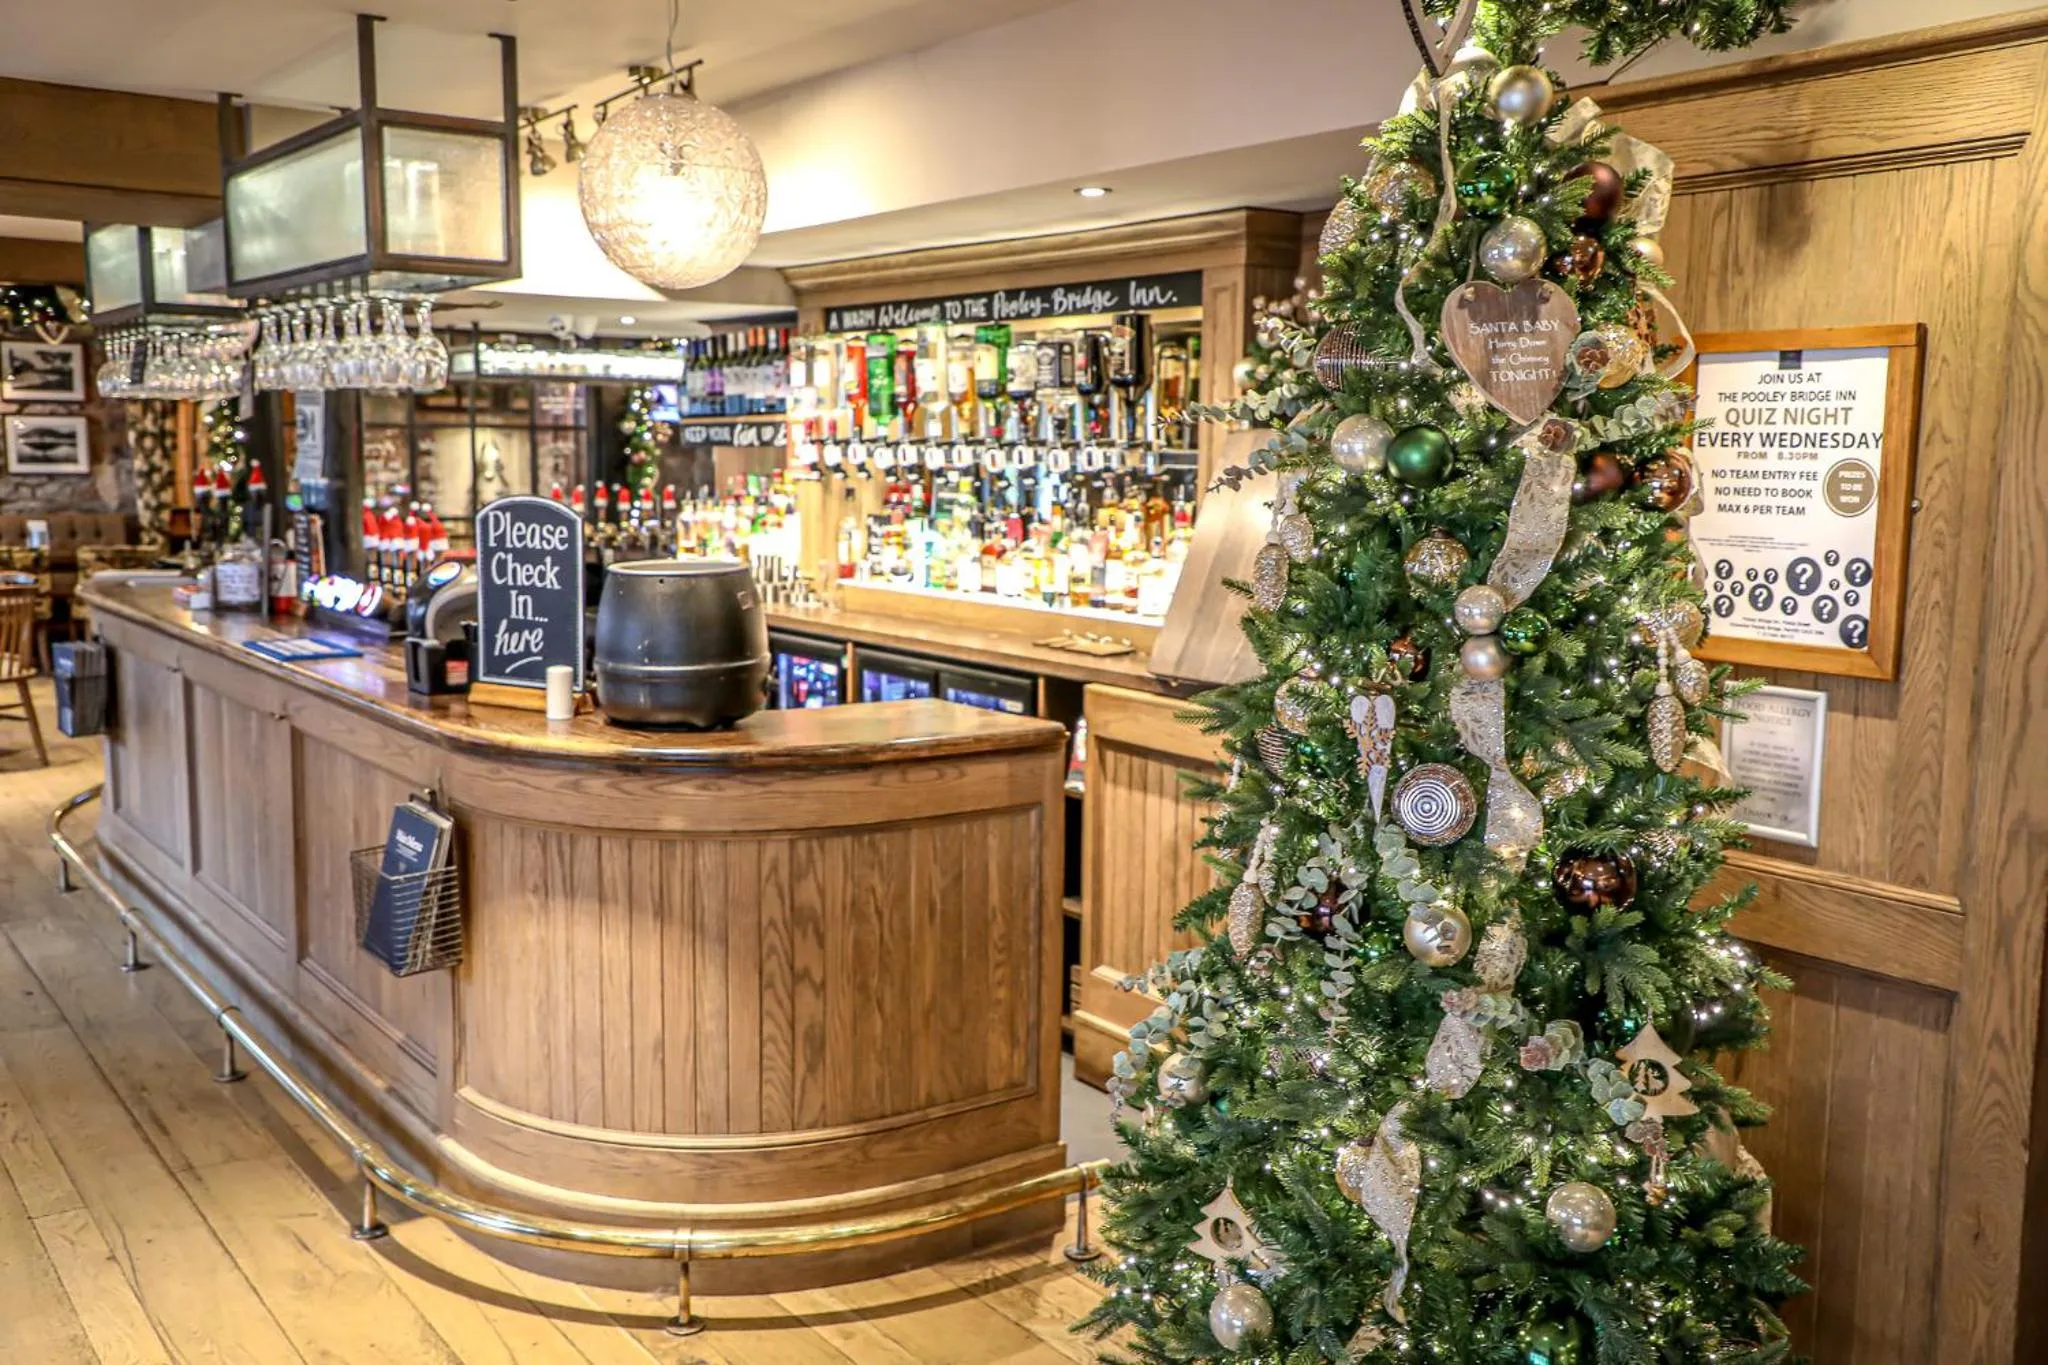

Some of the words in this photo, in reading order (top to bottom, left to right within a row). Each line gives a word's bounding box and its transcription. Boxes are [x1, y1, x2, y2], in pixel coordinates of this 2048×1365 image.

[829, 312, 840, 331] A
[842, 309, 875, 330] WARM
[944, 300, 962, 319] TO
[964, 297, 988, 318] THE
[1051, 286, 1119, 315] Bridge
[1469, 321, 1519, 335] SANTA
[1523, 320, 1560, 333] BABY
[1758, 373, 1785, 385] JOIN
[1788, 373, 1803, 384] US
[1806, 372, 1822, 384] AT
[1718, 392, 1737, 403] THE
[1741, 391, 1786, 403] POOLEY
[1790, 390, 1832, 402] BRIDGE
[1836, 390, 1857, 401] INN
[1725, 407, 1777, 427] QUIZ
[1784, 407, 1854, 426] NIGHT
[1697, 432, 1754, 448] EVERY
[1760, 432, 1883, 449] WEDNESDAY
[1737, 451, 1768, 460] FROM
[1777, 451, 1818, 461] 8.30PM
[1711, 469, 1727, 479] NO
[1729, 469, 1759, 480] TEAM
[1762, 470, 1797, 481] ENTRY
[1799, 471, 1818, 481] FEE
[1714, 486, 1731, 497] NO
[1733, 487, 1762, 497] NEED
[1765, 487, 1779, 498] TO
[1781, 488, 1813, 499] BOOK
[1717, 503, 1742, 514] MAX
[1743, 505, 1750, 515] 6
[1753, 504, 1773, 515] PER
[1775, 505, 1806, 516] TEAM
[488, 510, 569, 551] Please
[490, 551, 562, 590] Check
[494, 618, 544, 656] here
